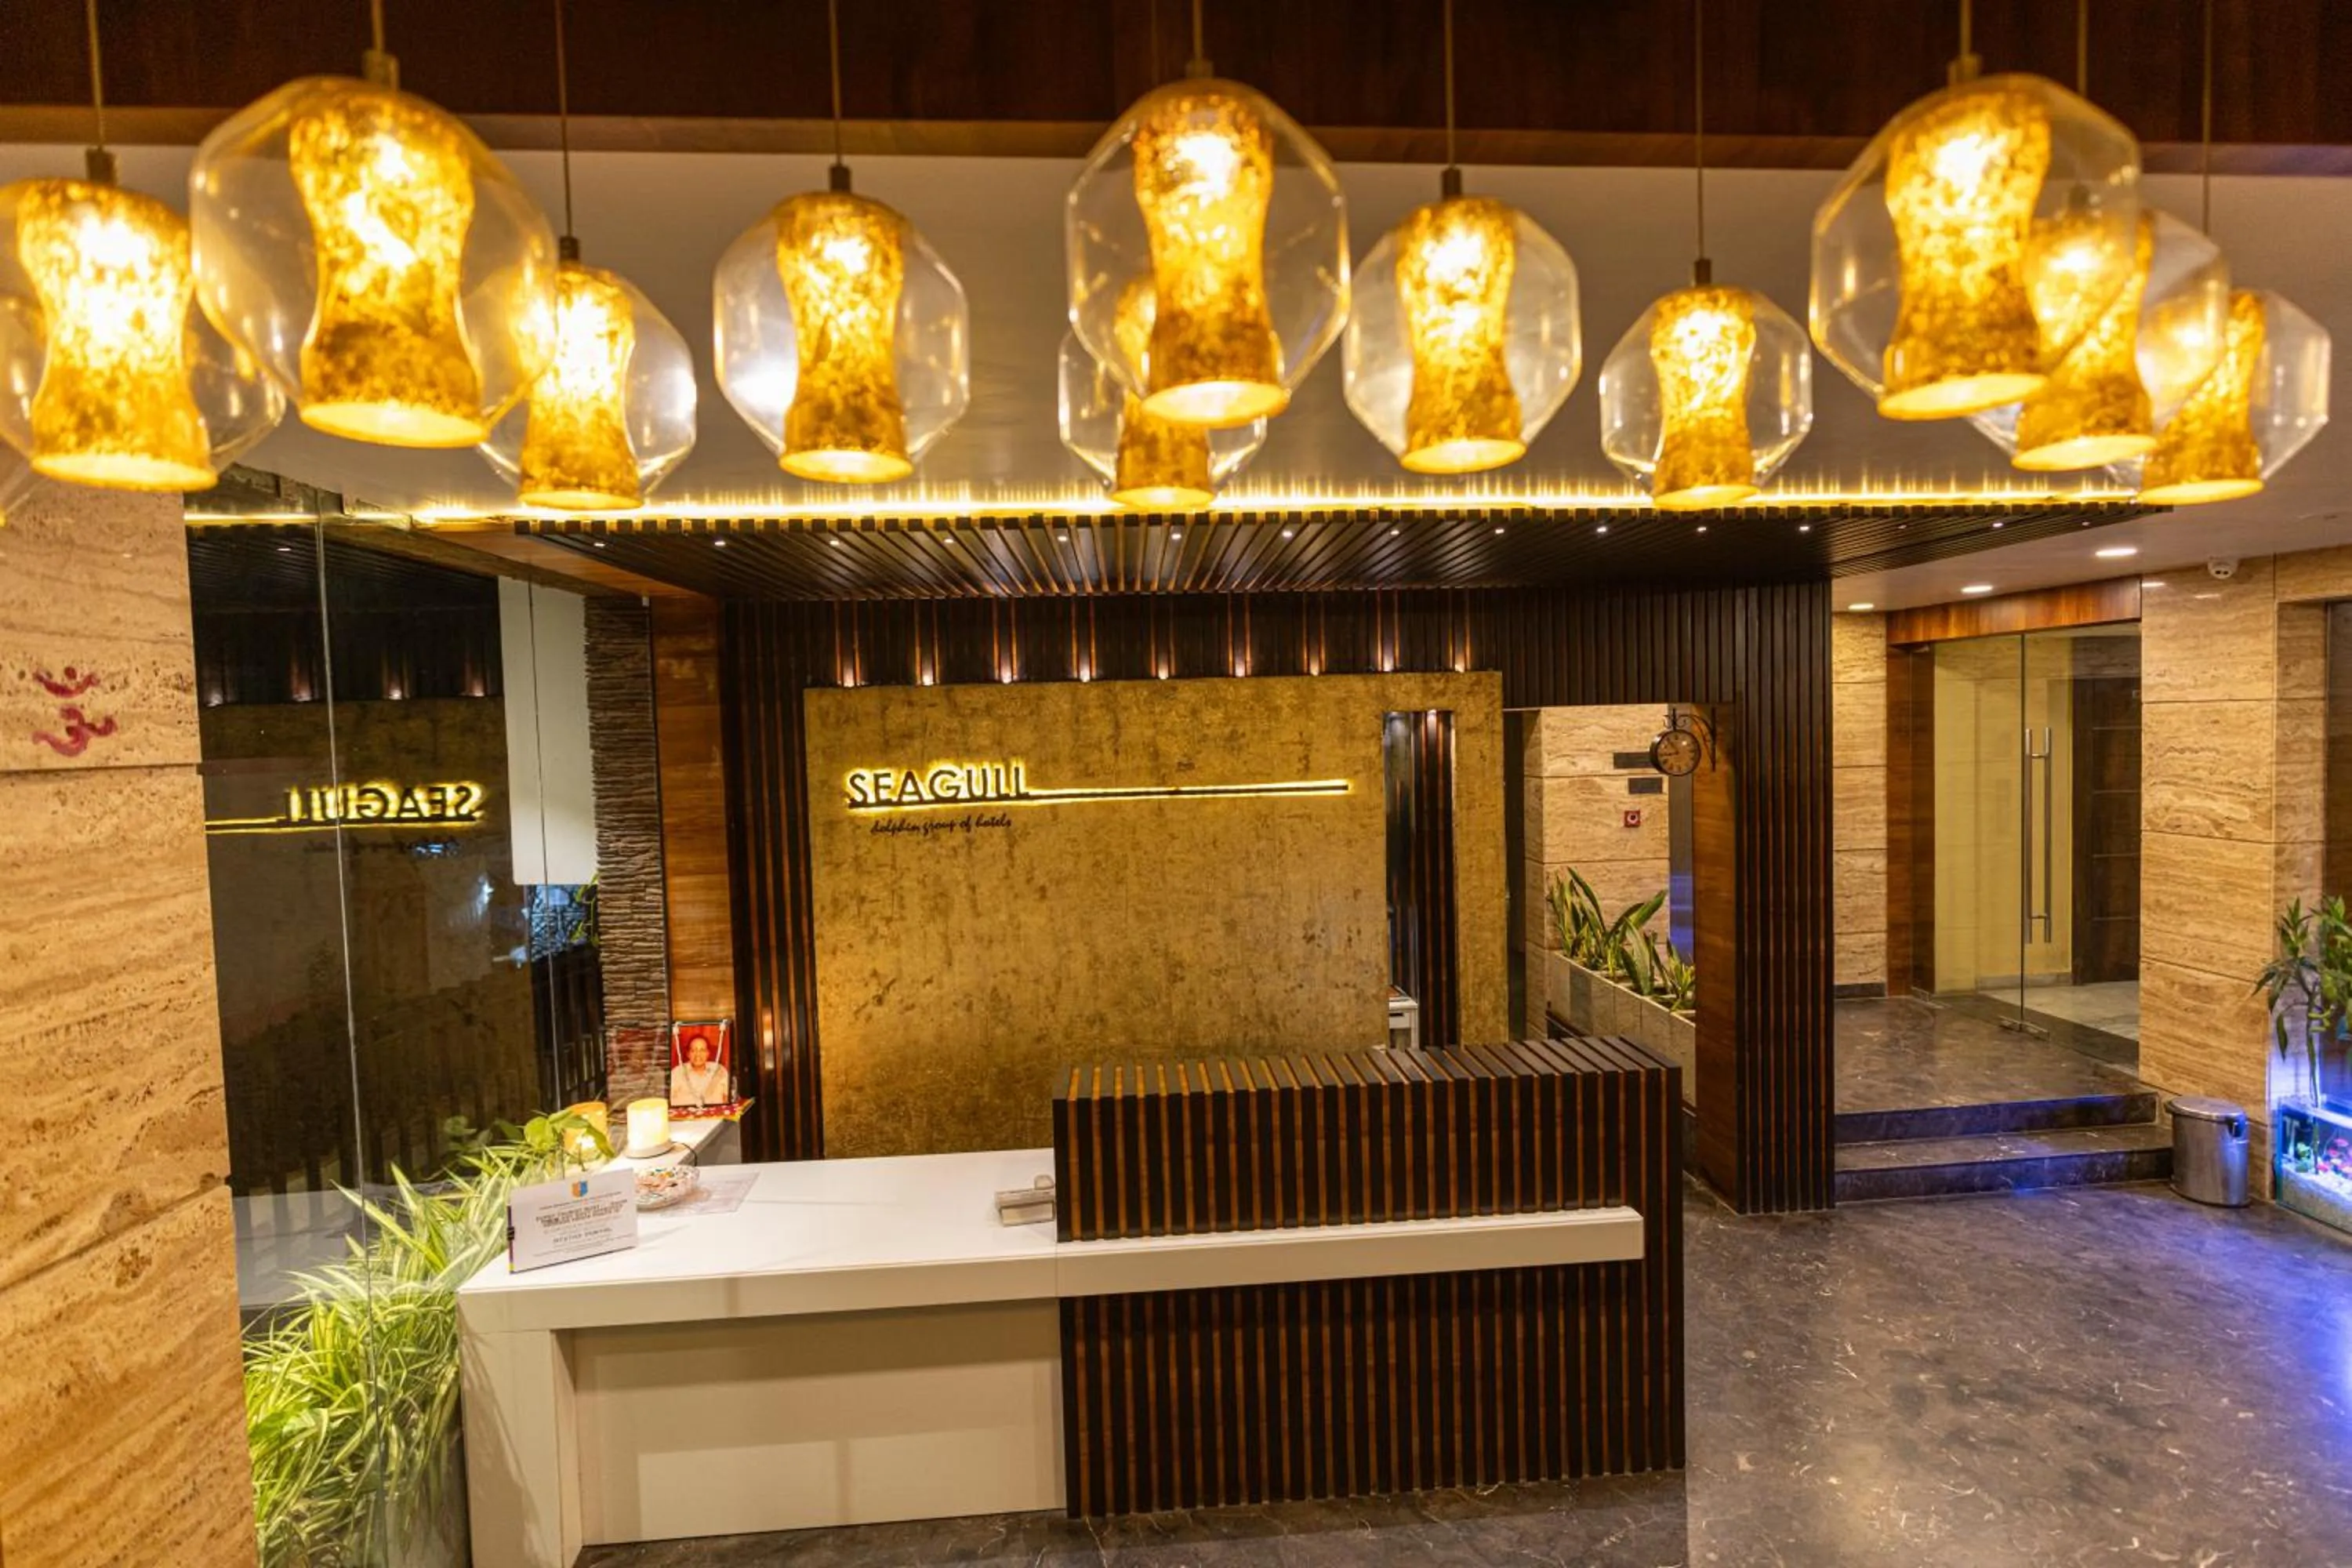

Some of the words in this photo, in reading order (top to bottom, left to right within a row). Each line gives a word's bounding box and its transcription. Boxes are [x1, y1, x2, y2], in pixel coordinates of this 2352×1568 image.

[847, 766, 1029, 808] SEAGULL
[870, 818, 920, 837] dolphin
[922, 819, 956, 836] group
[960, 815, 971, 833] of
[975, 812, 1011, 828] hotels
